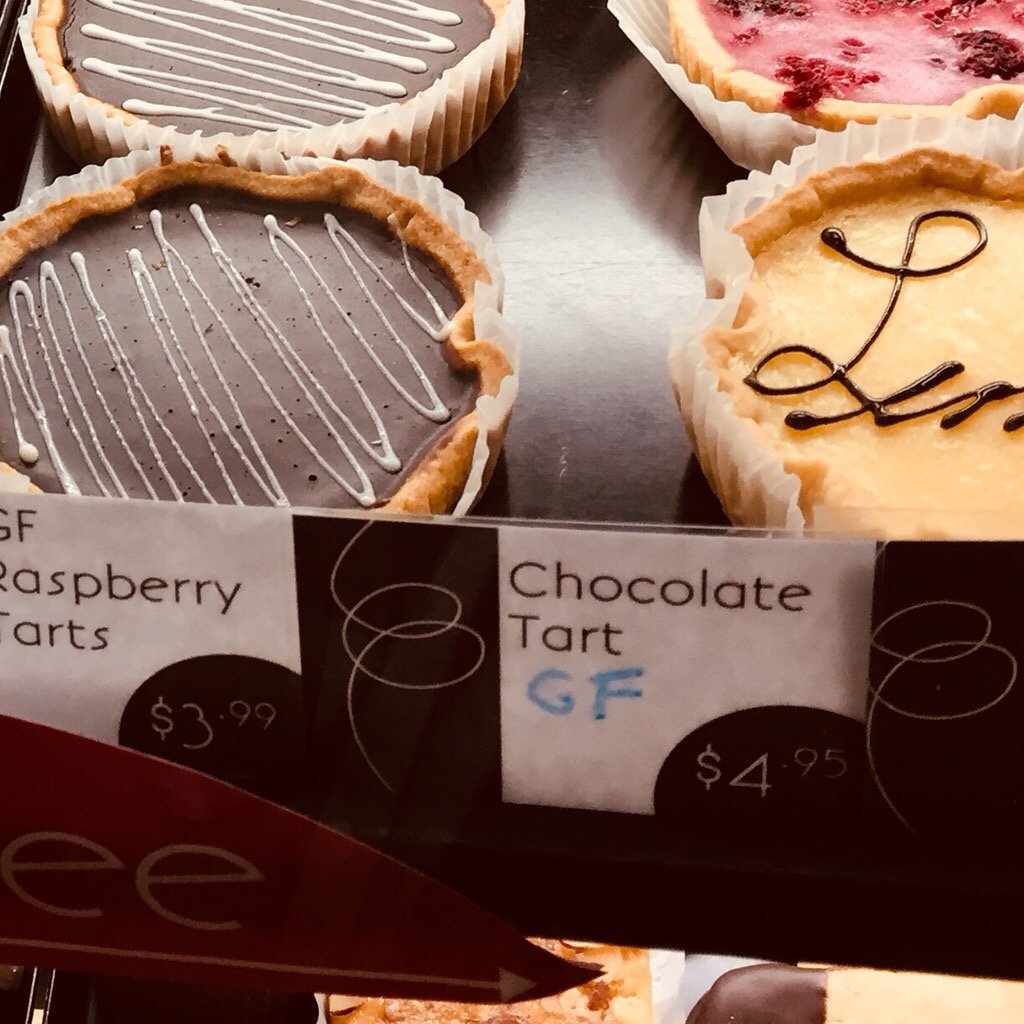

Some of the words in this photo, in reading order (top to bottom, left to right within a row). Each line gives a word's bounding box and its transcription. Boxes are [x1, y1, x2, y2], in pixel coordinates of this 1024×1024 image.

[509, 561, 812, 611] Chocolate
[508, 613, 623, 656] Tart
[527, 667, 644, 720] GF
[150, 696, 277, 750] $3.99
[696, 743, 848, 798] $4.95
